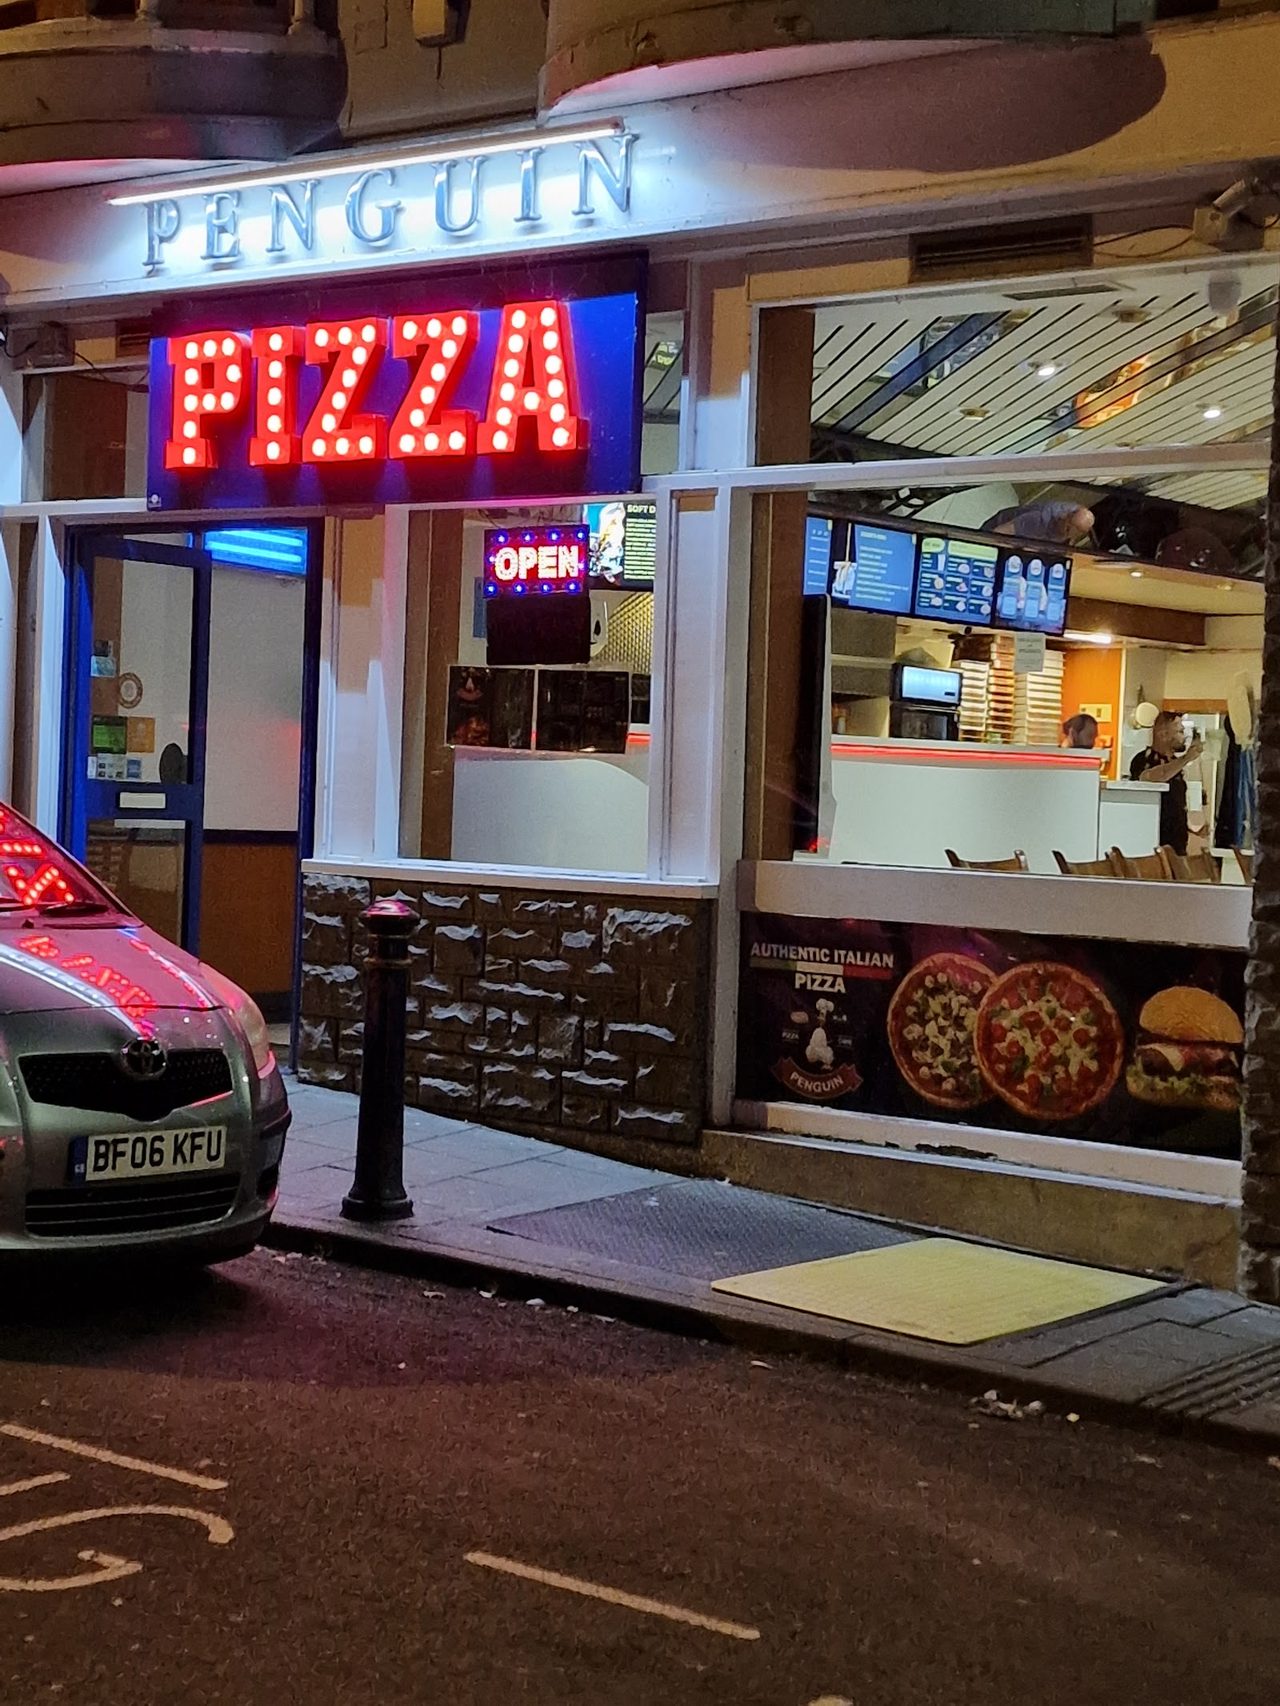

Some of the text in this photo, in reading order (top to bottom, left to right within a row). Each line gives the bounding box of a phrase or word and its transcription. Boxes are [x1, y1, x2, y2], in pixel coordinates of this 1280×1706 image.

[142, 132, 638, 266] PENGUIN
[165, 300, 587, 469] PIZZA
[494, 545, 579, 581] OPEN
[750, 942, 894, 968] AUTHENTIC ITALIAN
[794, 973, 846, 993] PIZZA
[790, 1071, 844, 1093] PENGUIN
[93, 1130, 222, 1172] BF06 KFU
